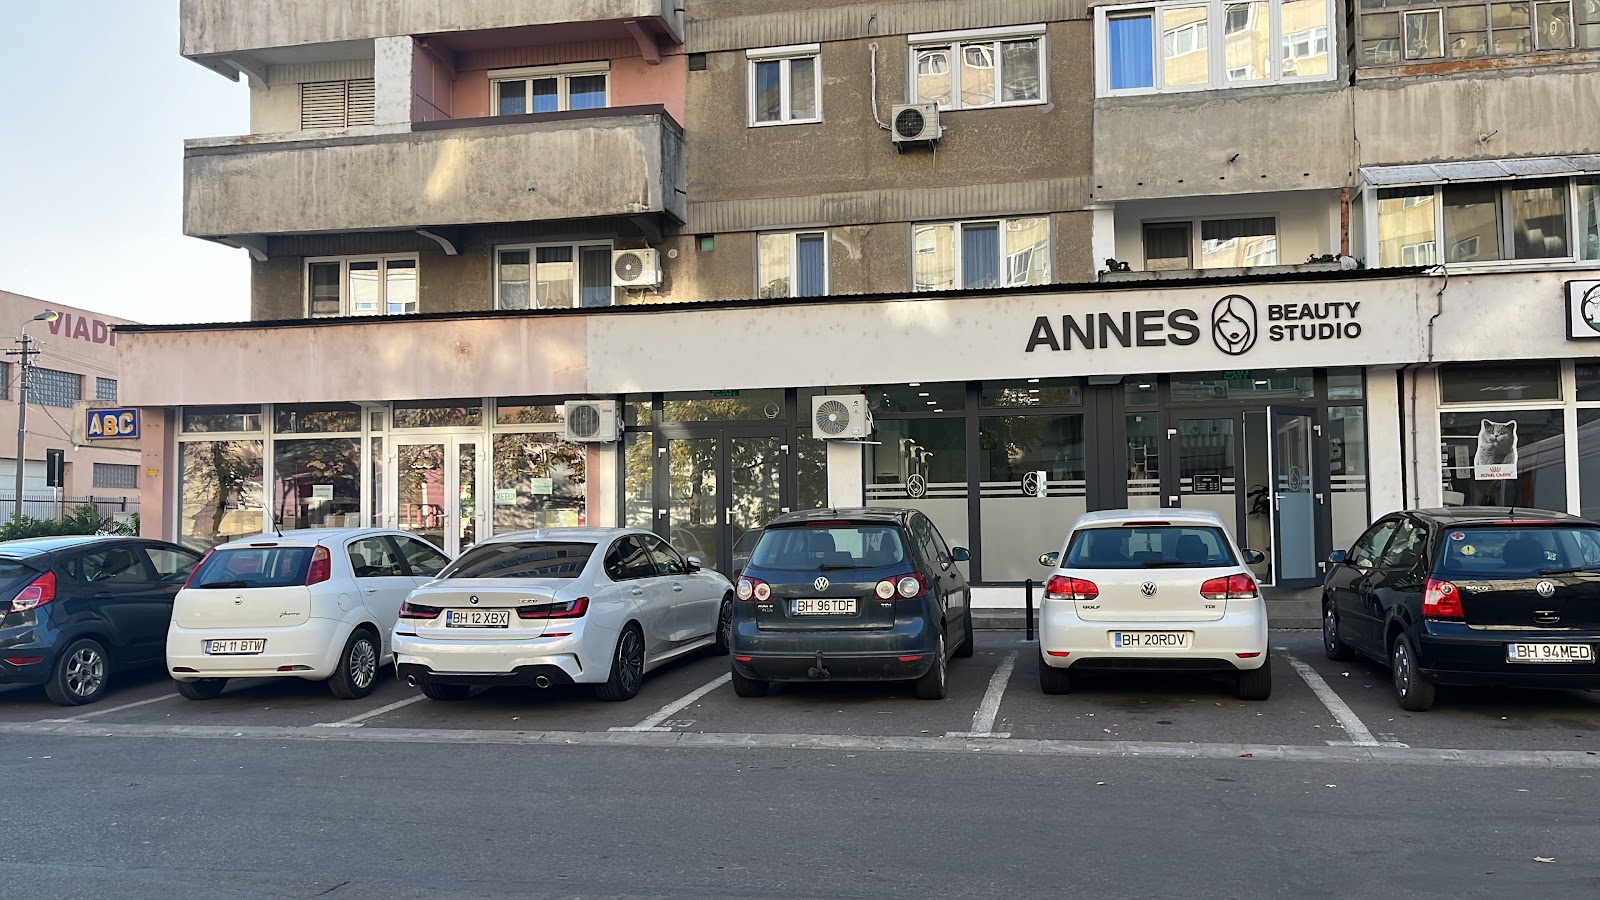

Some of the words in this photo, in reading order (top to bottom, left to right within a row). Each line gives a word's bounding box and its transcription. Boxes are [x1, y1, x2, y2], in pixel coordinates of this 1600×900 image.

[1268, 301, 1361, 321] BEAUTY
[1025, 308, 1200, 352] ANNES
[1269, 322, 1362, 342] STUDIO
[89, 412, 134, 435] ABC
[798, 601, 814, 612] BH
[453, 613, 468, 624] BH
[471, 613, 481, 624] 12
[483, 613, 507, 624] XBX
[212, 641, 227, 652] BH
[230, 641, 237, 652] 11
[241, 640, 263, 651] BTW
[1122, 634, 1140, 646] BH
[1517, 645, 1538, 658] BH
